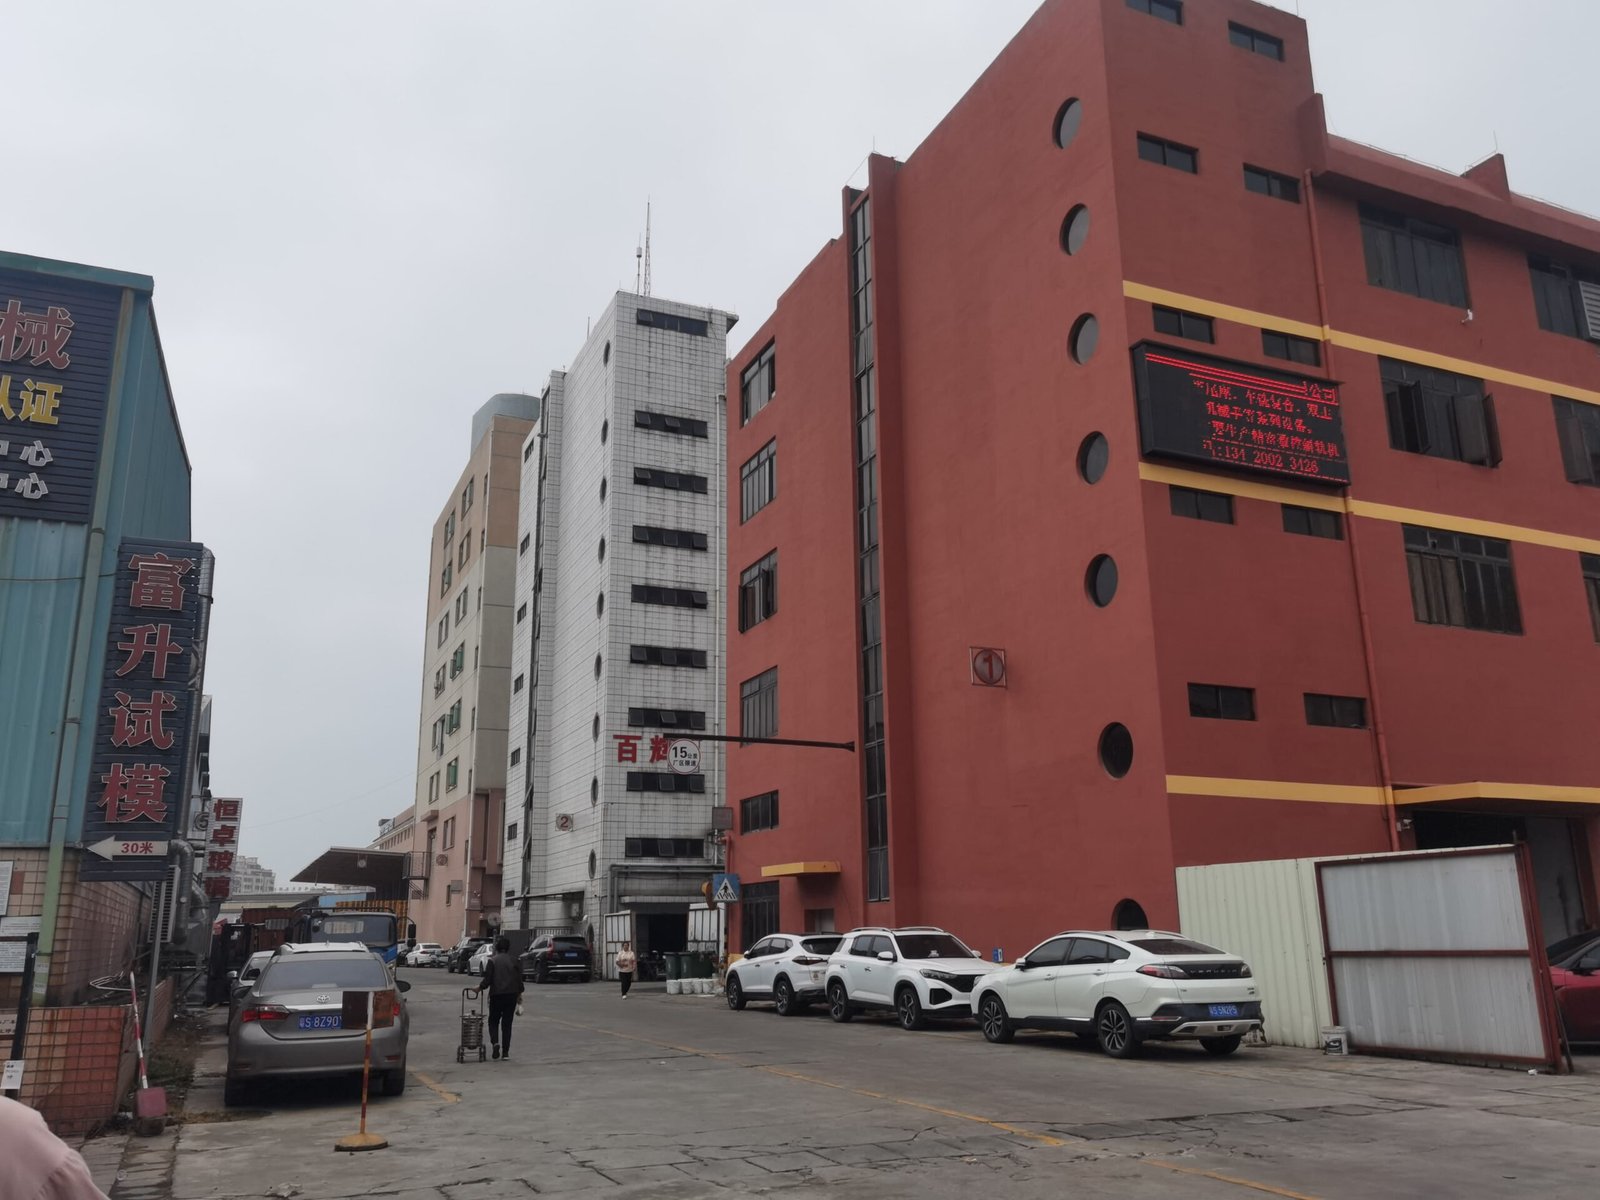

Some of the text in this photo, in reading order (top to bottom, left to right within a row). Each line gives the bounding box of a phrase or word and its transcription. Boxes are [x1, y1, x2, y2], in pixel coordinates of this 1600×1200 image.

[98, 552, 194, 824] 富升试模
[120, 842, 154, 855] 30米
